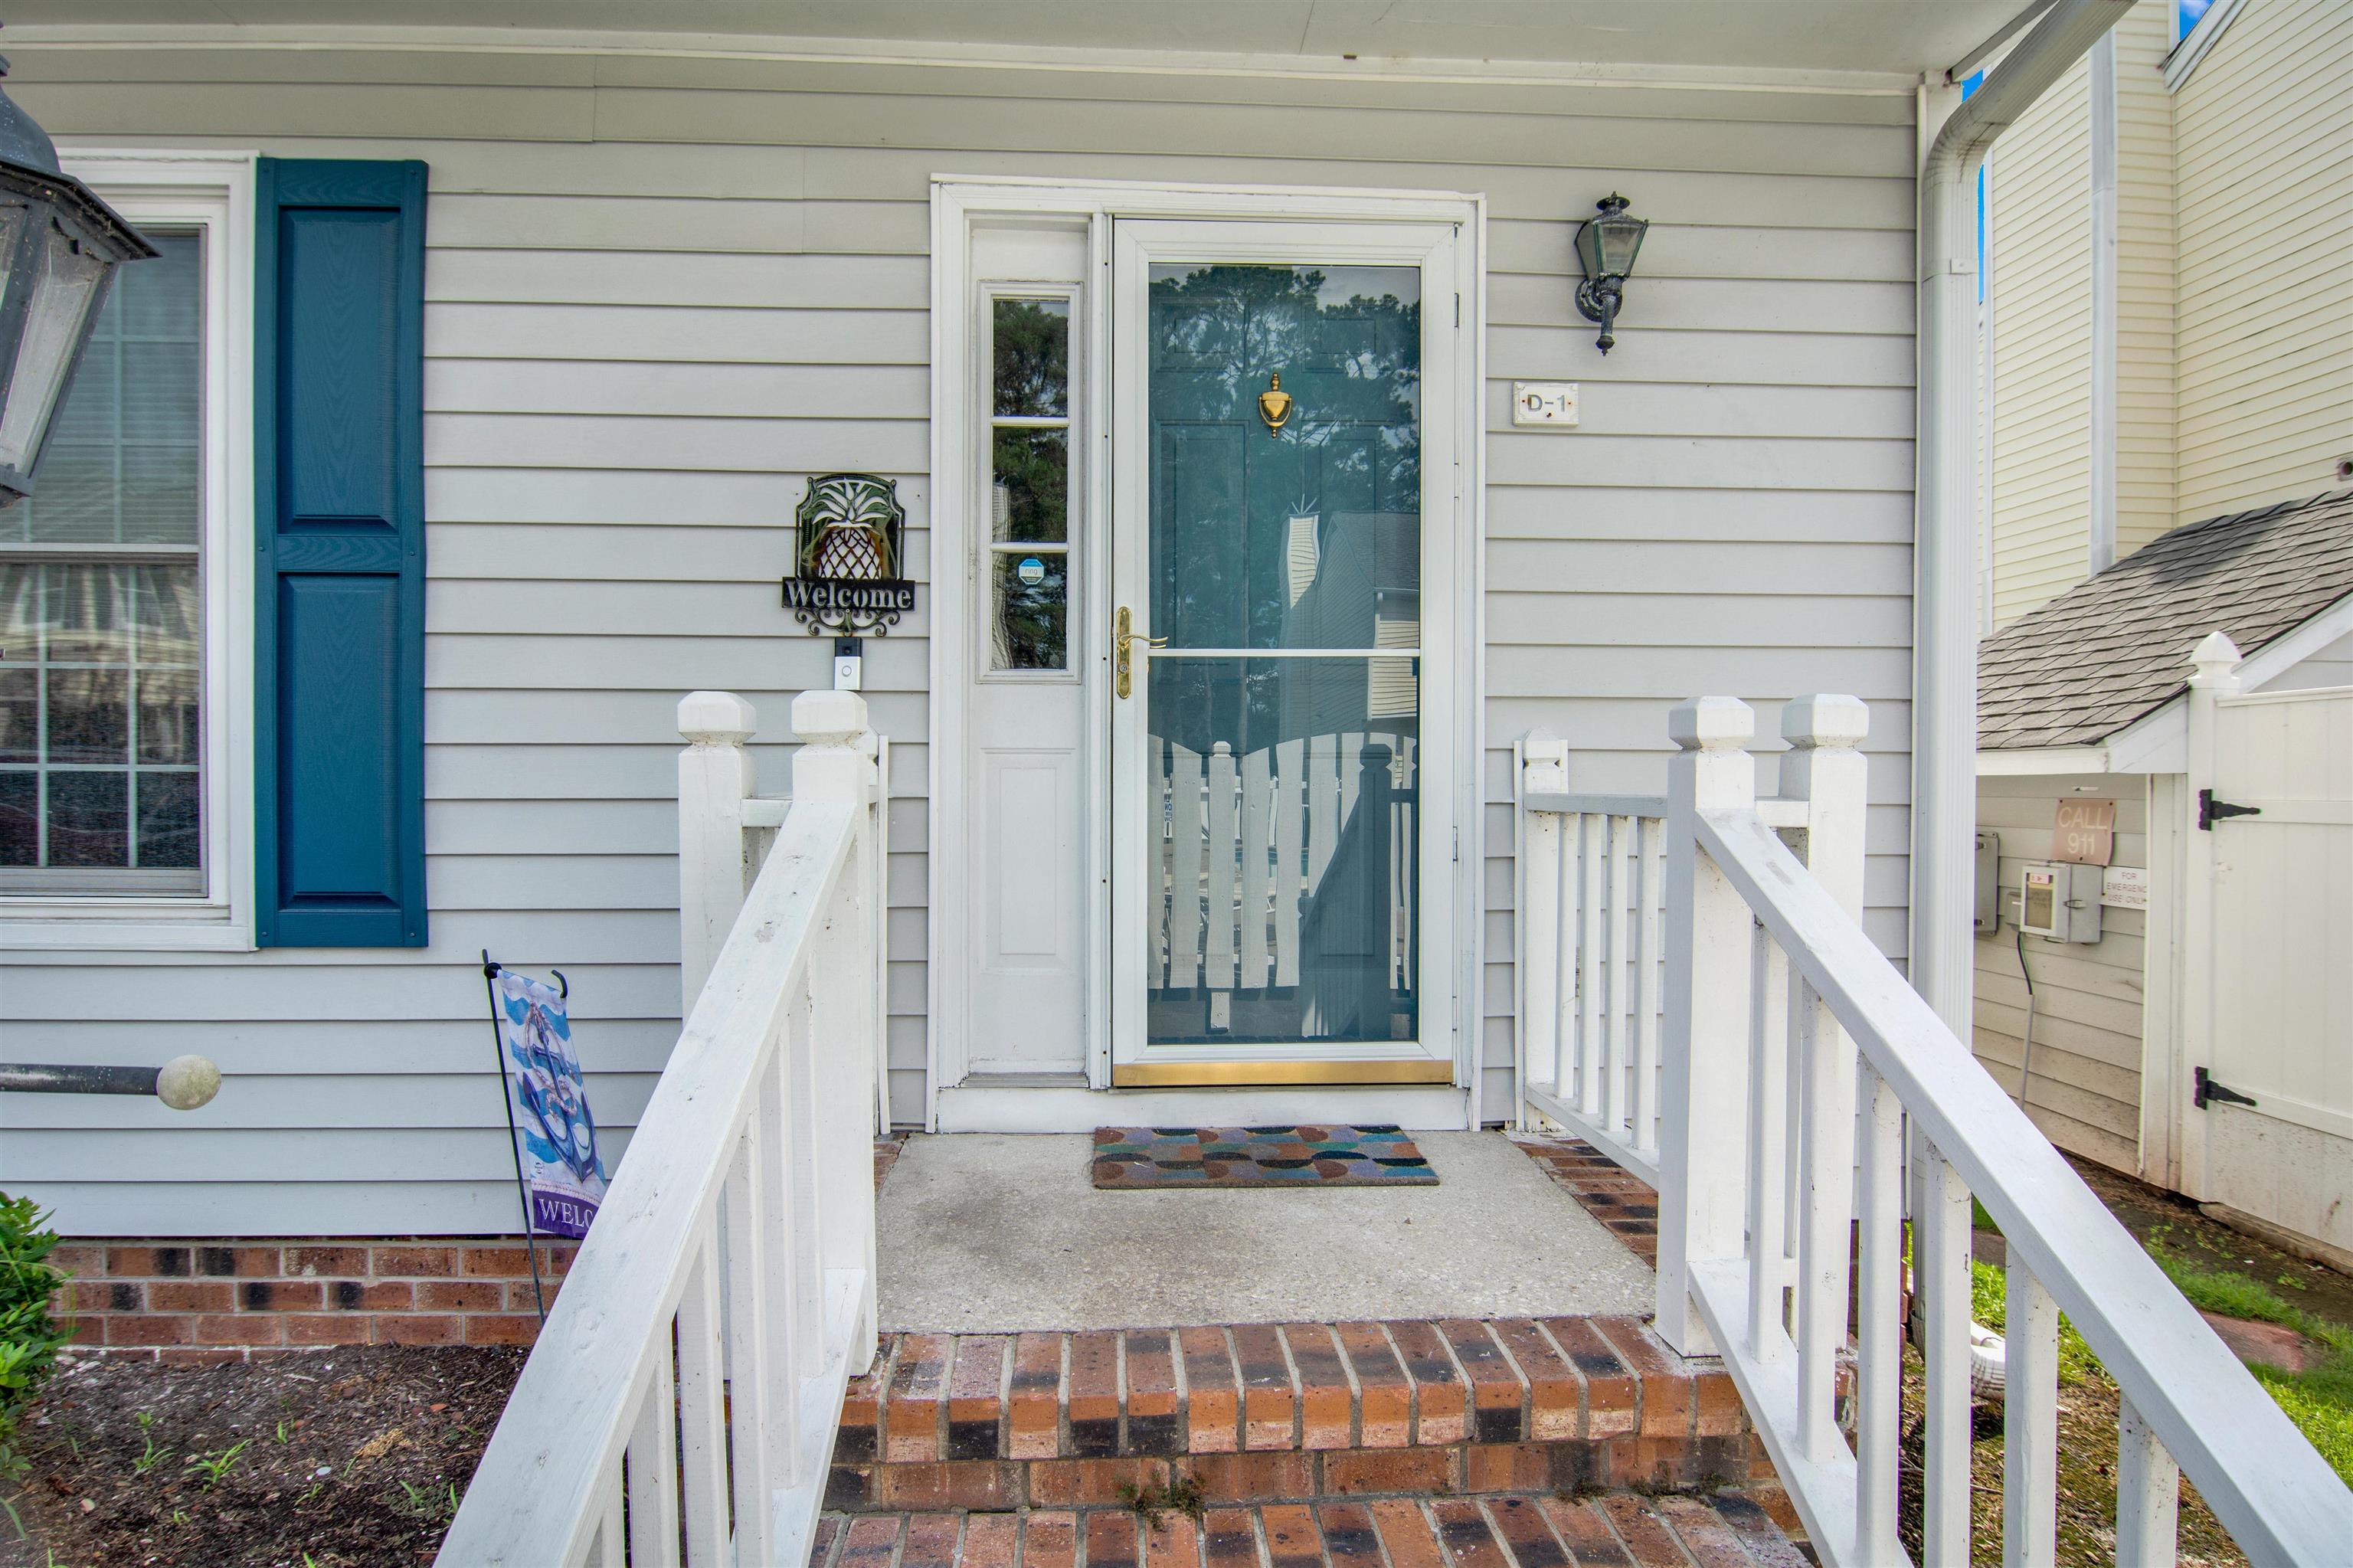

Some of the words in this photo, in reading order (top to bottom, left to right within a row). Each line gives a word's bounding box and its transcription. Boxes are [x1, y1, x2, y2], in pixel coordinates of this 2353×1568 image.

[1527, 394, 1565, 412] D-1
[785, 580, 911, 609] Welcome
[2058, 807, 2108, 829] CALL
[2067, 833, 2096, 856] 911
[2121, 872, 2136, 880] FOR
[2106, 882, 2147, 893] EMERGENC
[2108, 894, 2122, 902] USE
[538, 1198, 594, 1229] WELC
